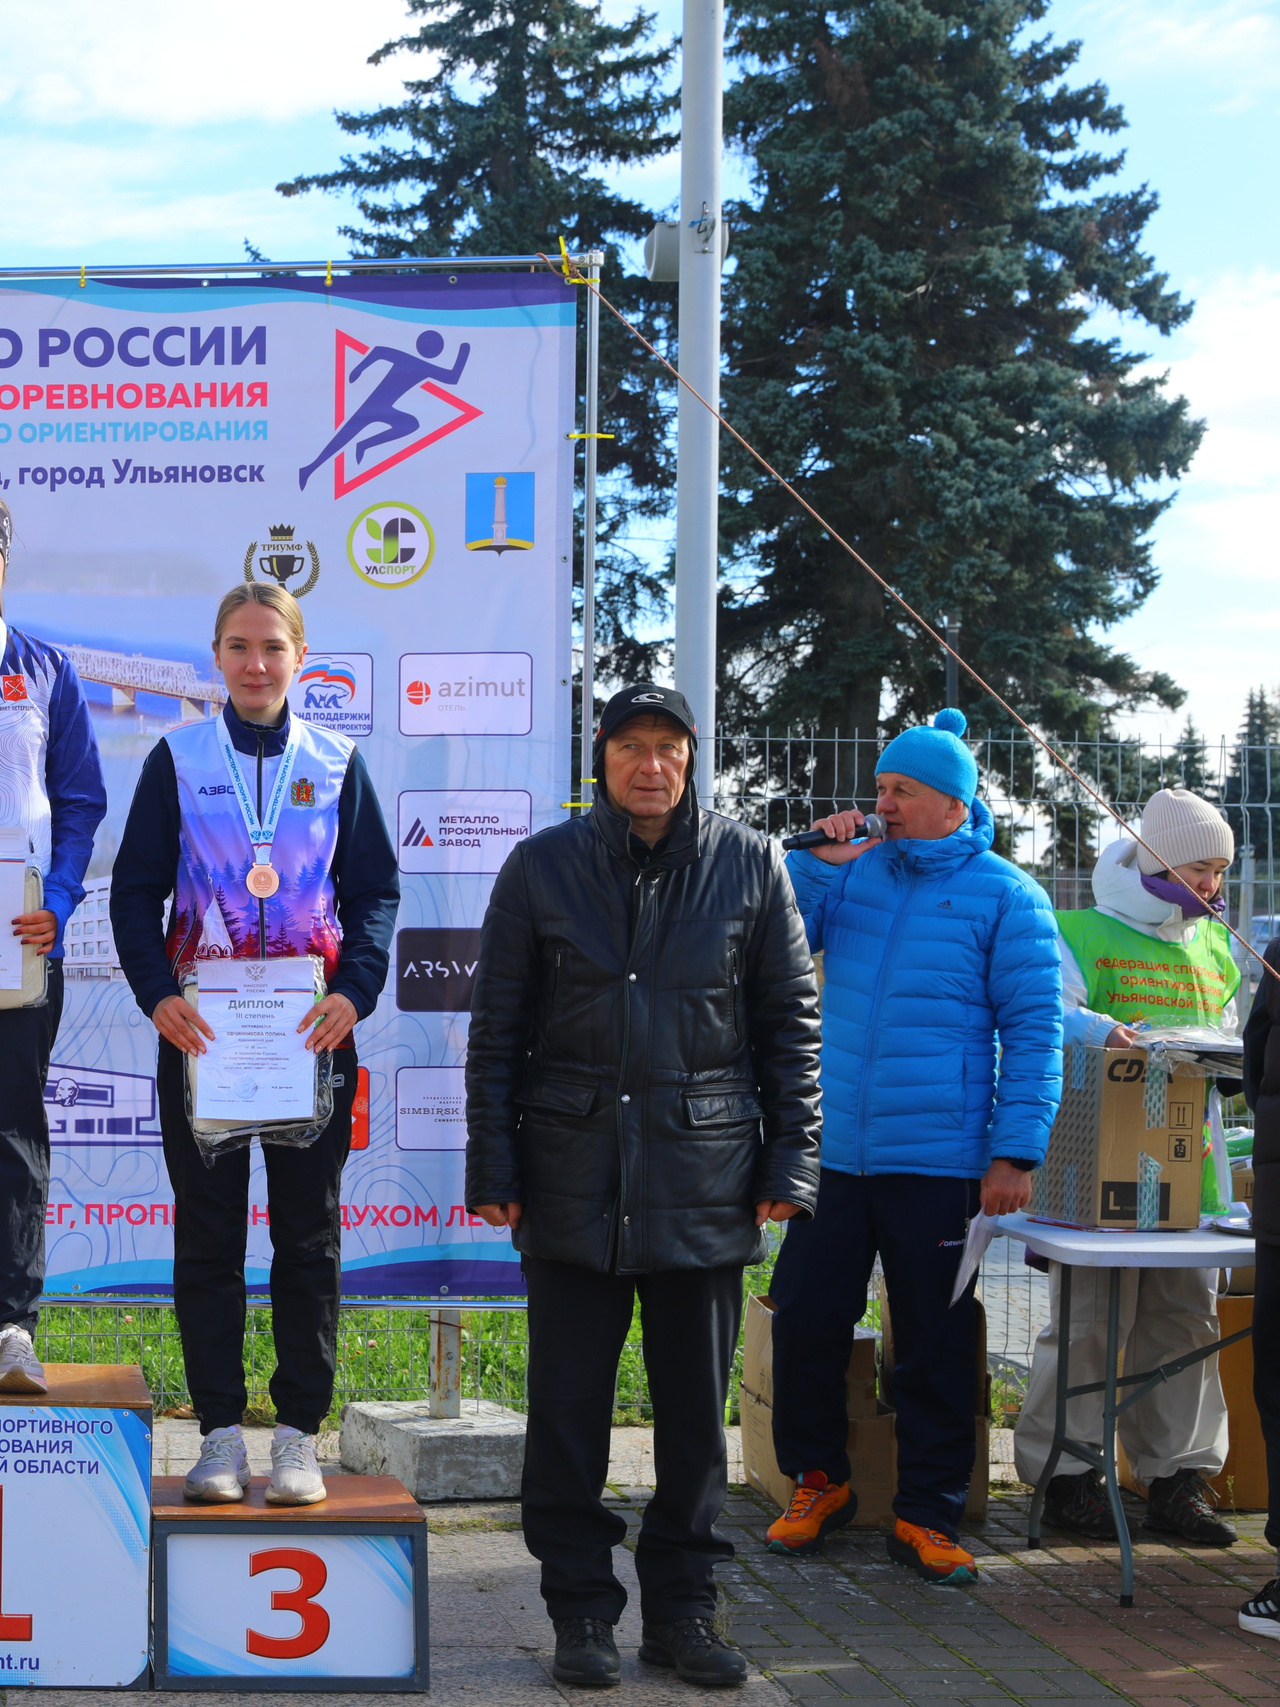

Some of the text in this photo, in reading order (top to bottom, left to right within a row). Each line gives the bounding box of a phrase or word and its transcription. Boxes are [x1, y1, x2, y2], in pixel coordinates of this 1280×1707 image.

[38, 326, 267, 368] РОССИИ
[18, 420, 268, 444] ОРИЕНТИРОВАНИЯ
[19, 466, 105, 492] город
[112, 459, 265, 484] Ульяновск
[261, 543, 303, 553] ТРИУМФ
[365, 565, 416, 575] УЛСПОРТ
[438, 676, 526, 697] azimut
[313, 712, 370, 721] ПОДДЕРЖКИ
[439, 815, 499, 824] МЕТАЛЛО
[439, 826, 528, 836] ПРОФИЛЬНЫЙ
[439, 838, 481, 848] ЗАВОД
[403, 961, 478, 978] ARSW
[1120, 975, 1222, 997] ориентирования
[228, 1000, 284, 1010] ДИПЛОМ
[1108, 1058, 1173, 1084] CD
[1176, 1145, 1185, 1153] 12
[1108, 1191, 1120, 1210] L
[44, 1203, 75, 1228] ЕГ,
[13, 1459, 99, 1475] ОБЛАСТИ
[246, 1547, 331, 1659] 3
